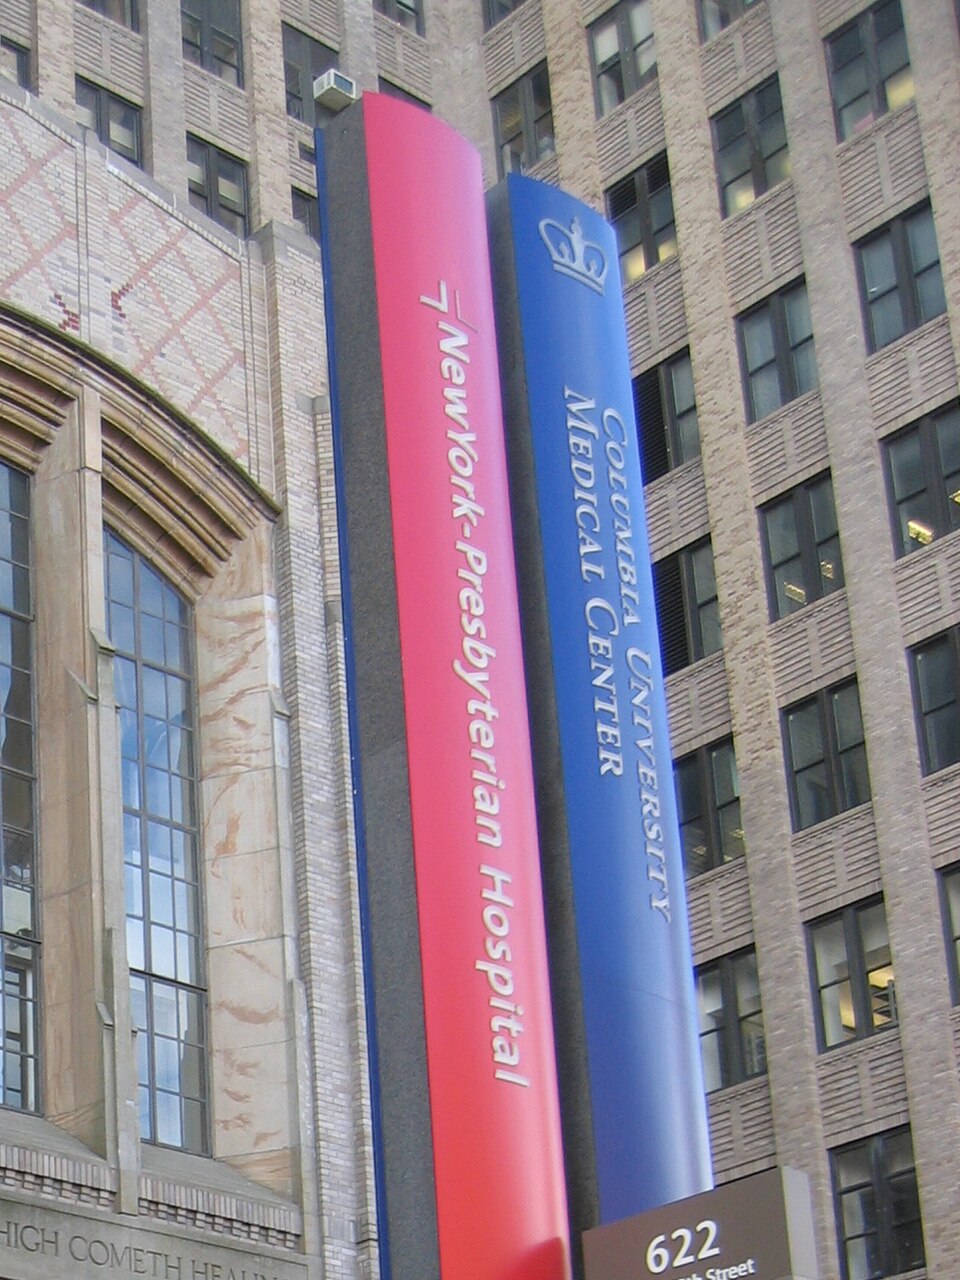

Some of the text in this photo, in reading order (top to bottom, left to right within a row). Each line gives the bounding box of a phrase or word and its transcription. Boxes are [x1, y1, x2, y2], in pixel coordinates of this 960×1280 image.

[437, 321, 530, 1088] NewYork-Presbyterian Hospital
[564, 386, 624, 778] MEDICAL CENTER
[602, 406, 672, 923] COLUMBIA UNIVERSITY
[645, 1220, 721, 1274] 622
